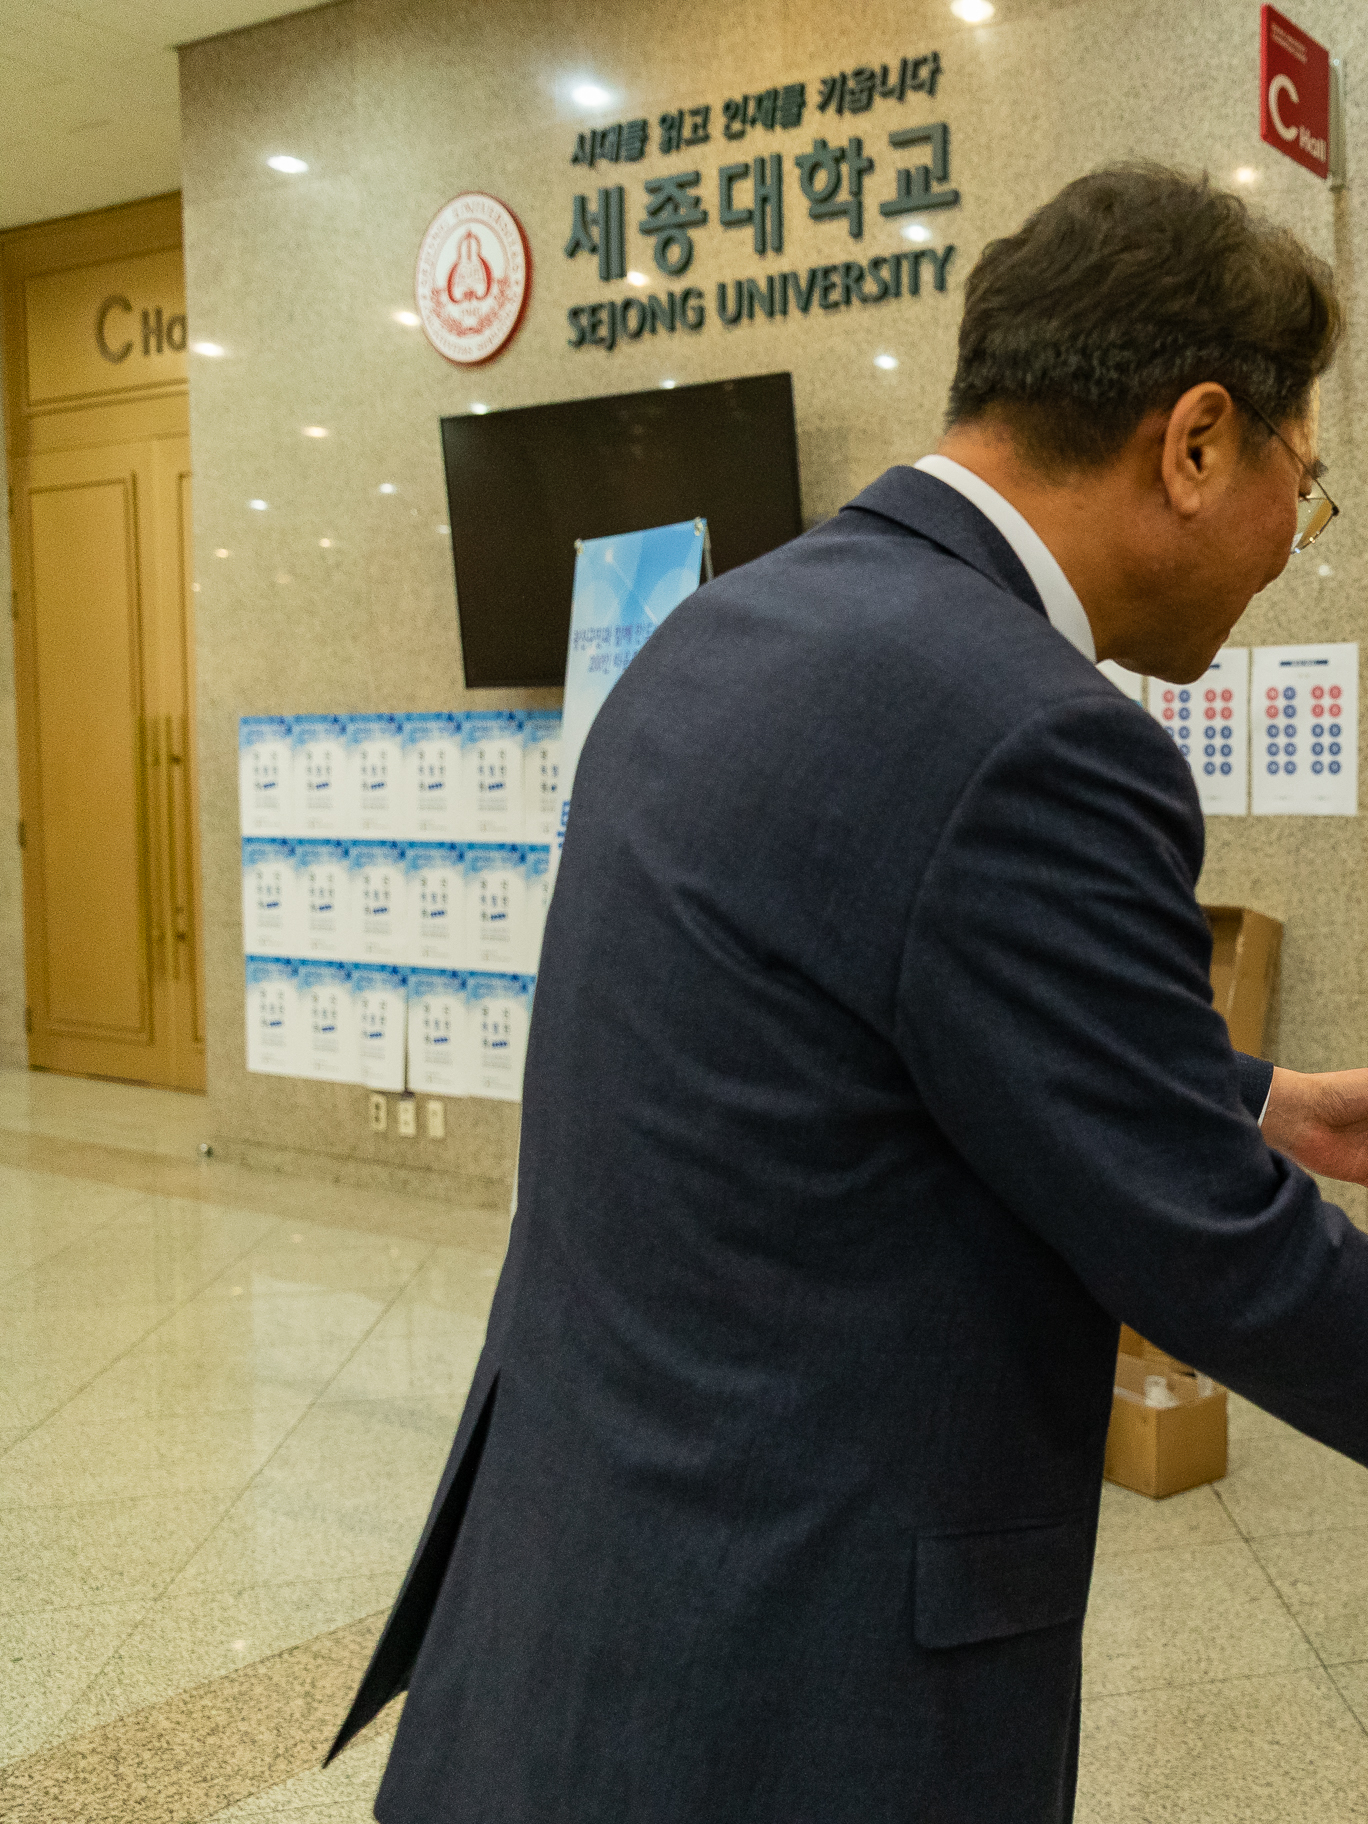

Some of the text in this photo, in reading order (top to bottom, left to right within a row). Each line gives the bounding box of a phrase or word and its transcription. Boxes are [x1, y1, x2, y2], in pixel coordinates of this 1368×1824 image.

[570, 118, 649, 168] 시대를
[658, 104, 711, 155] 읽고
[722, 82, 806, 141] 인재를
[1268, 73, 1300, 142] C
[565, 120, 960, 282] 세종대학교
[567, 245, 956, 351] SEJONG UNIVERSITY
